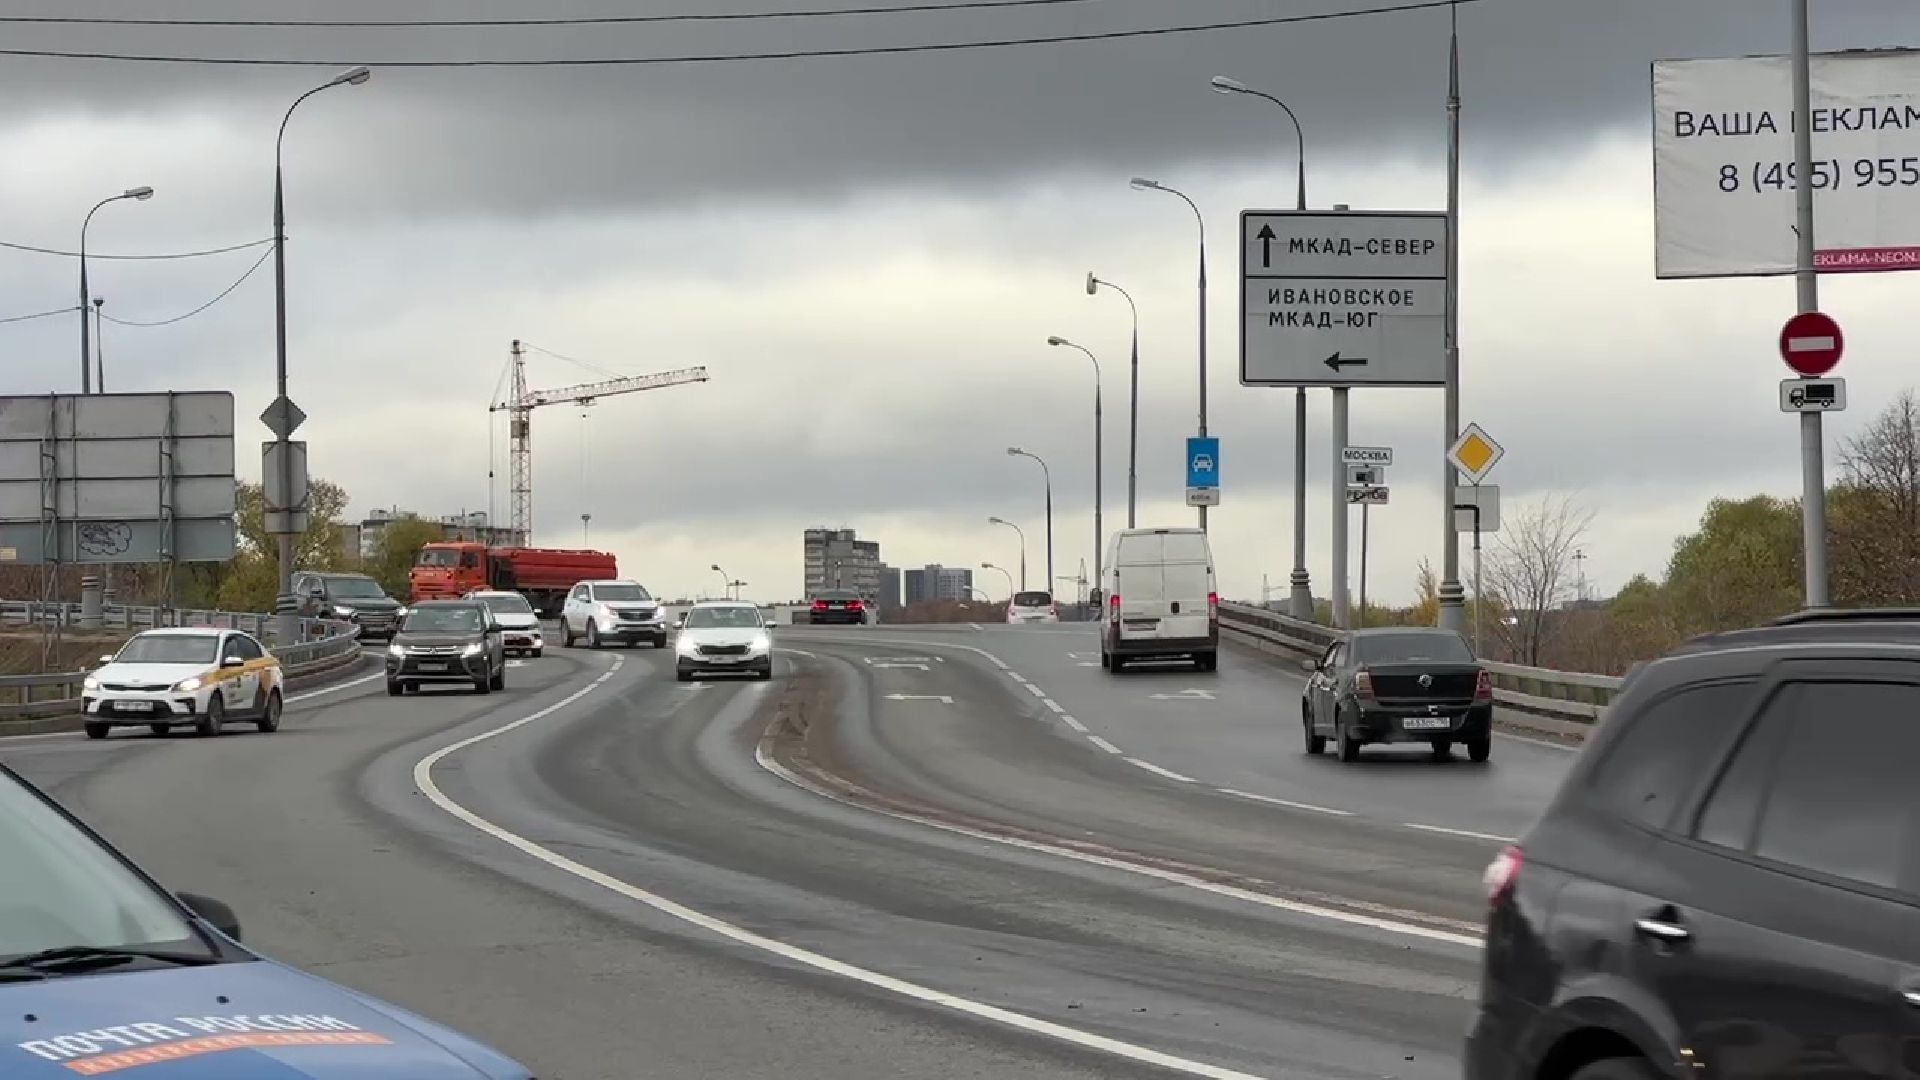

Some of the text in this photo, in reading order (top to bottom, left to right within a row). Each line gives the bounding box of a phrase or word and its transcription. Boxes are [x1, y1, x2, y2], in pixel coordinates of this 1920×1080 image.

[1675, 105, 1920, 136] ВАША ЕКЛАМ
[1719, 165, 1738, 192] 8
[1854, 157, 1919, 187] 955
[1289, 237, 1435, 256] МКАД-СЕВЕР
[1268, 288, 1414, 306] ИВАНОВСКОЕ
[1269, 311, 1378, 329] МКАД-ЮГ
[1344, 450, 1389, 461] МОСКВА
[16, 1022, 193, 1060] ПОЧТА
[174, 1014, 361, 1034] РОССИИ
